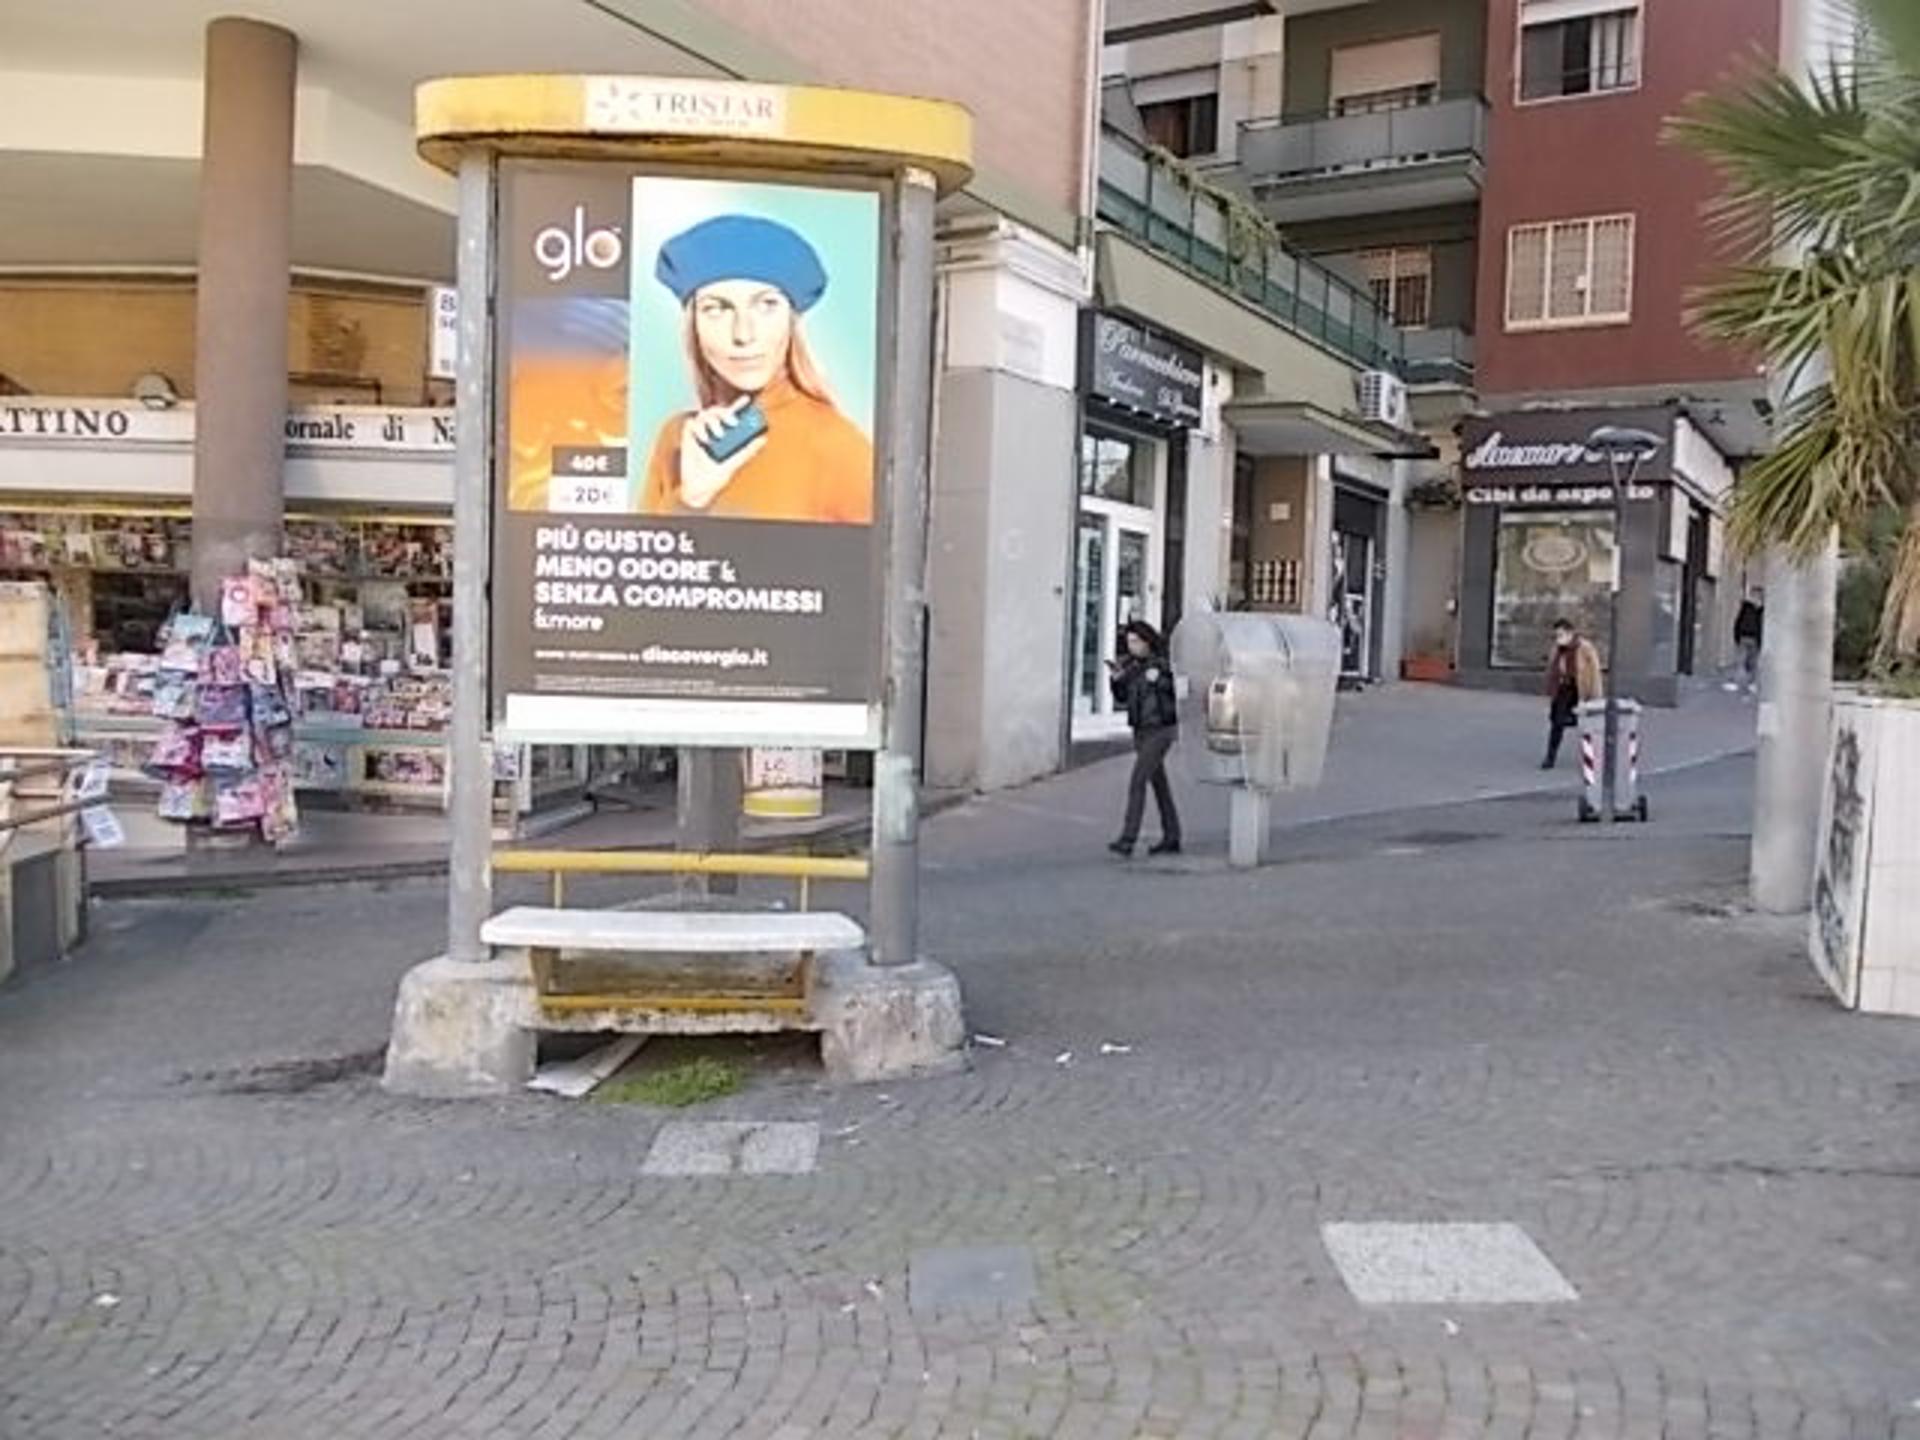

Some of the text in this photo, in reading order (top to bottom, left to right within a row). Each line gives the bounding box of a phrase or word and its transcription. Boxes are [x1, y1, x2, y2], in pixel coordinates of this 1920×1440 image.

[653, 92, 773, 118] TRISTAR
[536, 205, 622, 280] glo
[0, 408, 129, 436] TTINO
[382, 415, 404, 442] di
[1556, 485, 1654, 504] aspoto
[536, 523, 579, 550] PIÙ
[584, 530, 675, 553] GUSTO
[535, 555, 614, 578] MENO
[535, 581, 823, 613] SENZA COMPROMESSI
